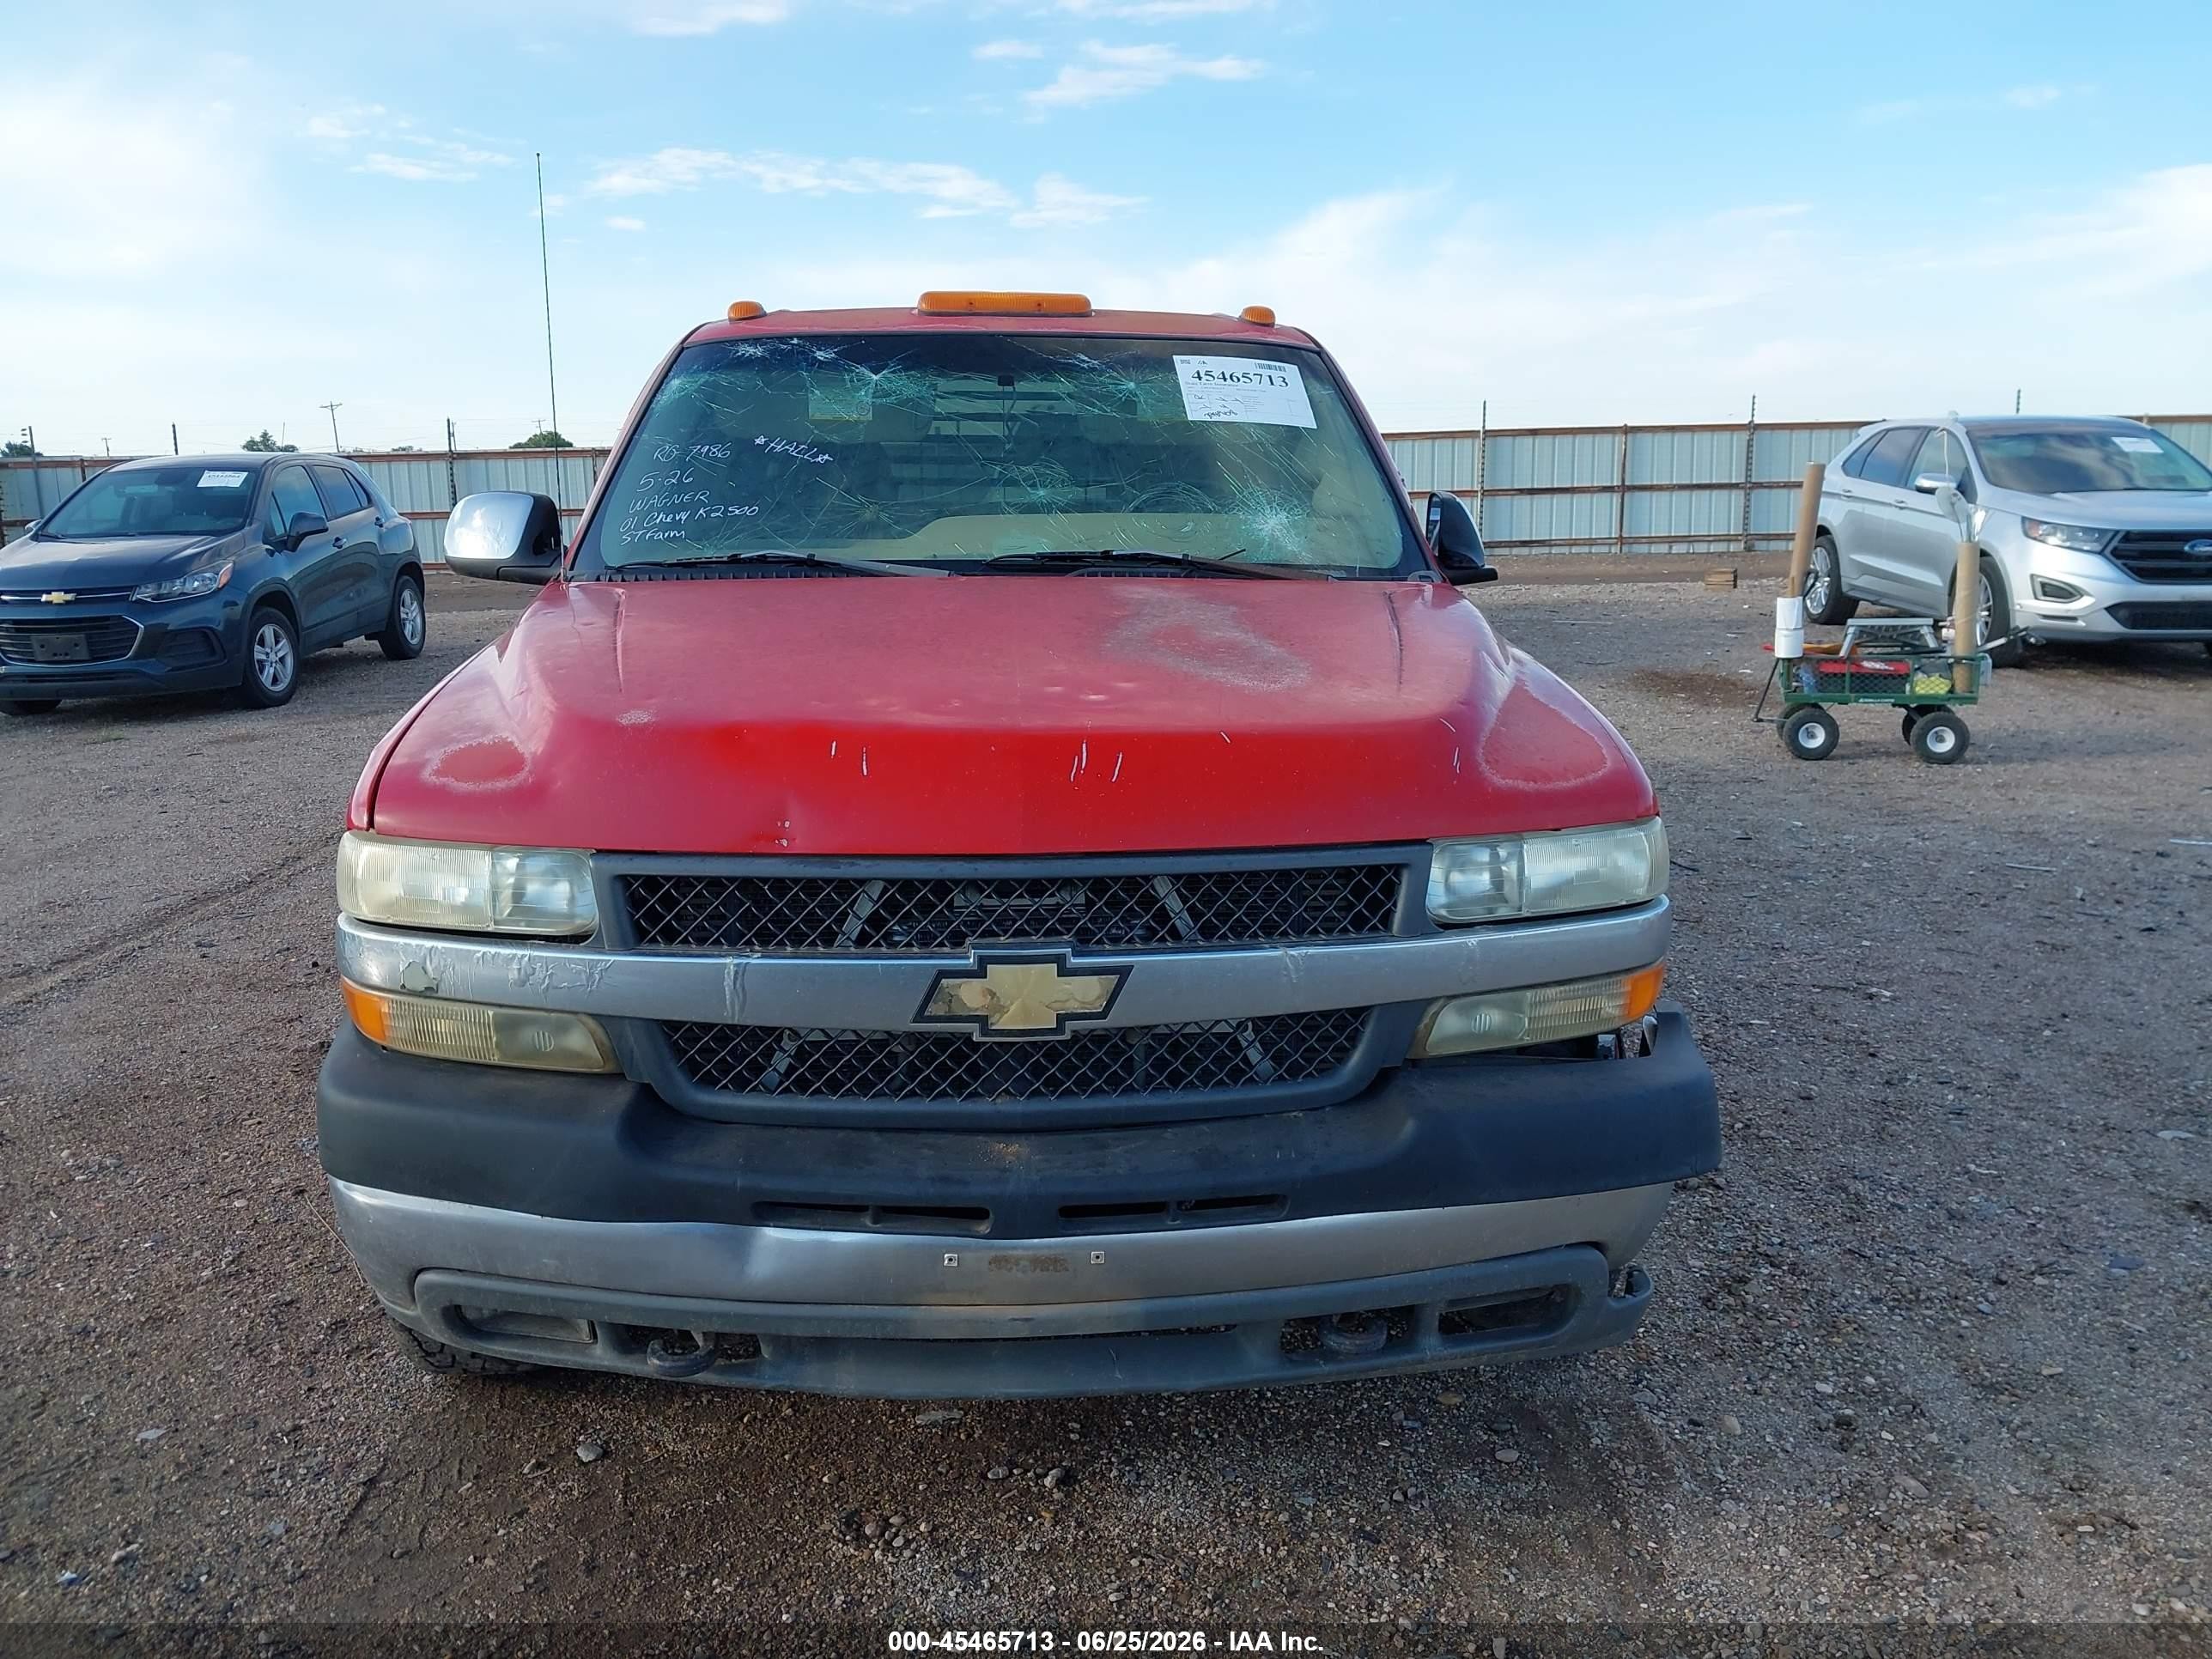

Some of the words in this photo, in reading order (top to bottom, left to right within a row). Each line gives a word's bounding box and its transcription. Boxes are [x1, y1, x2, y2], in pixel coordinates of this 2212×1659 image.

[1191, 369, 1290, 388] 45465713
[629, 490, 710, 514] WAGNER
[643, 510, 691, 527] Chevy
